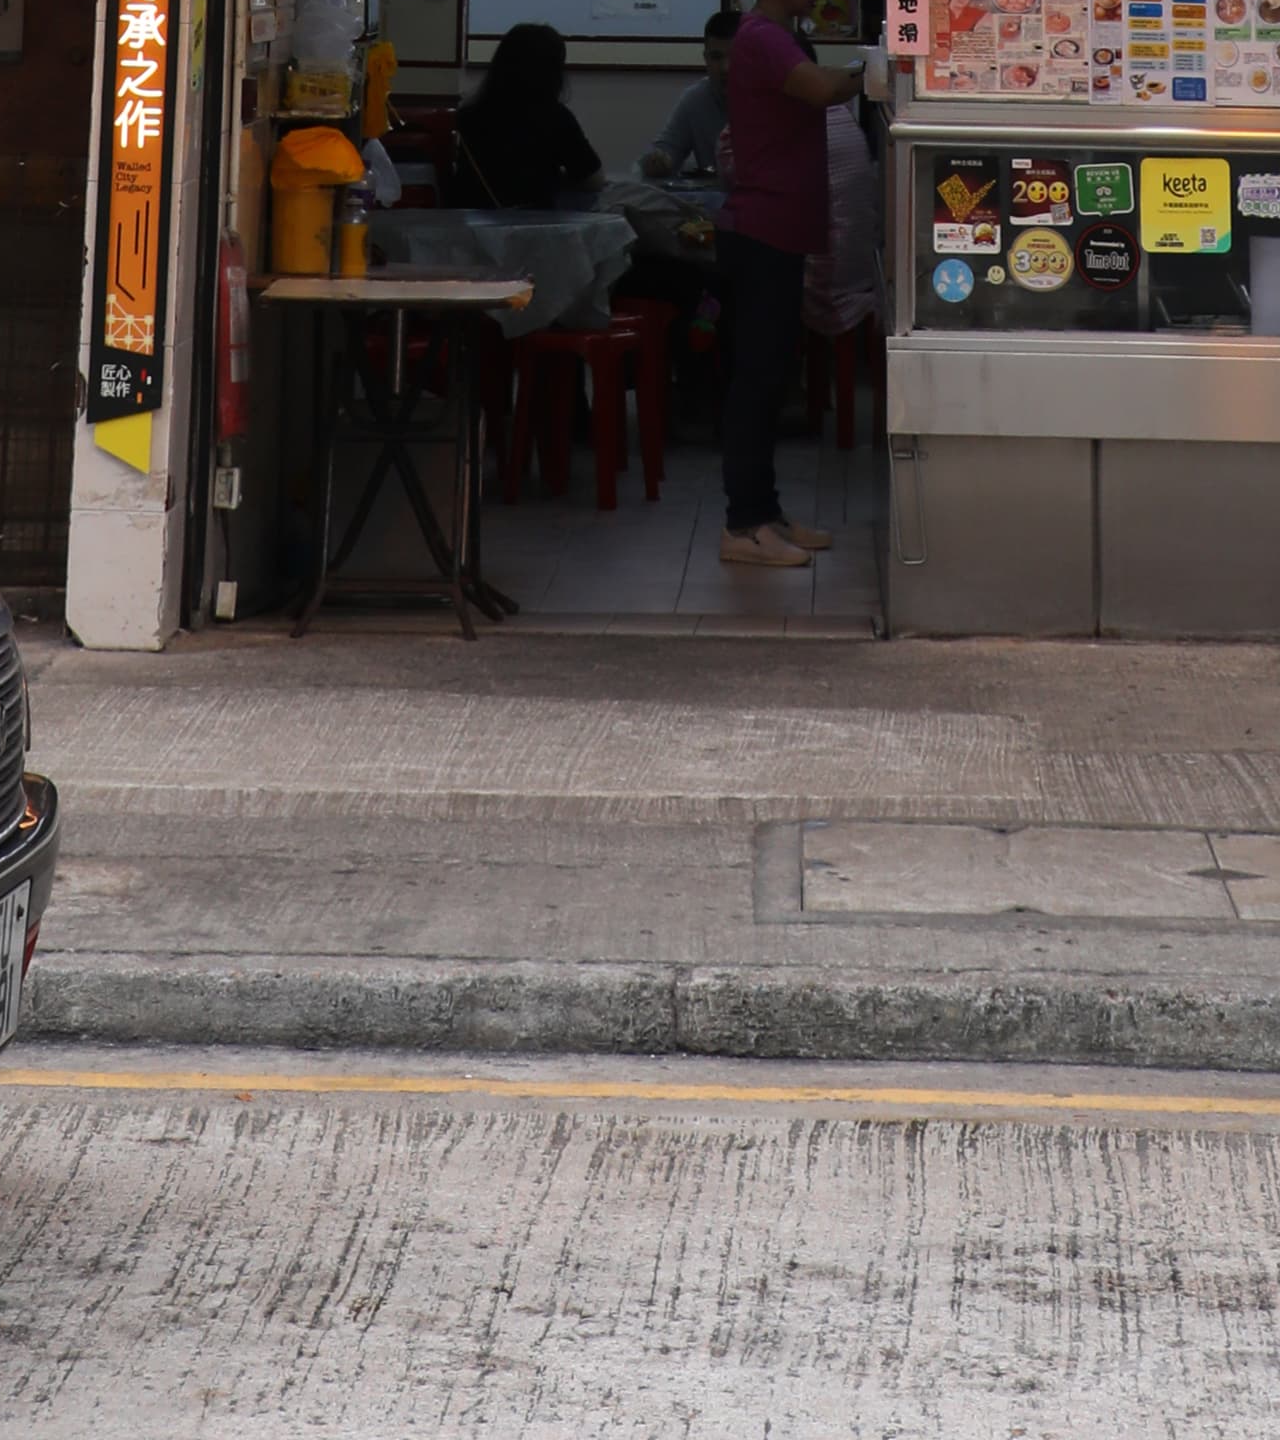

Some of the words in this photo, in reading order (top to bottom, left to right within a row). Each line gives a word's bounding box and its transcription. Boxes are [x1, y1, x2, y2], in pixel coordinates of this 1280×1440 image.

[116, 162, 152, 171] Walled
[115, 172, 138, 184] City
[1163, 174, 1207, 193] keeta
[115, 183, 152, 194] Legacy
[101, 364, 132, 380] 匠心
[101, 381, 131, 397] 製作
